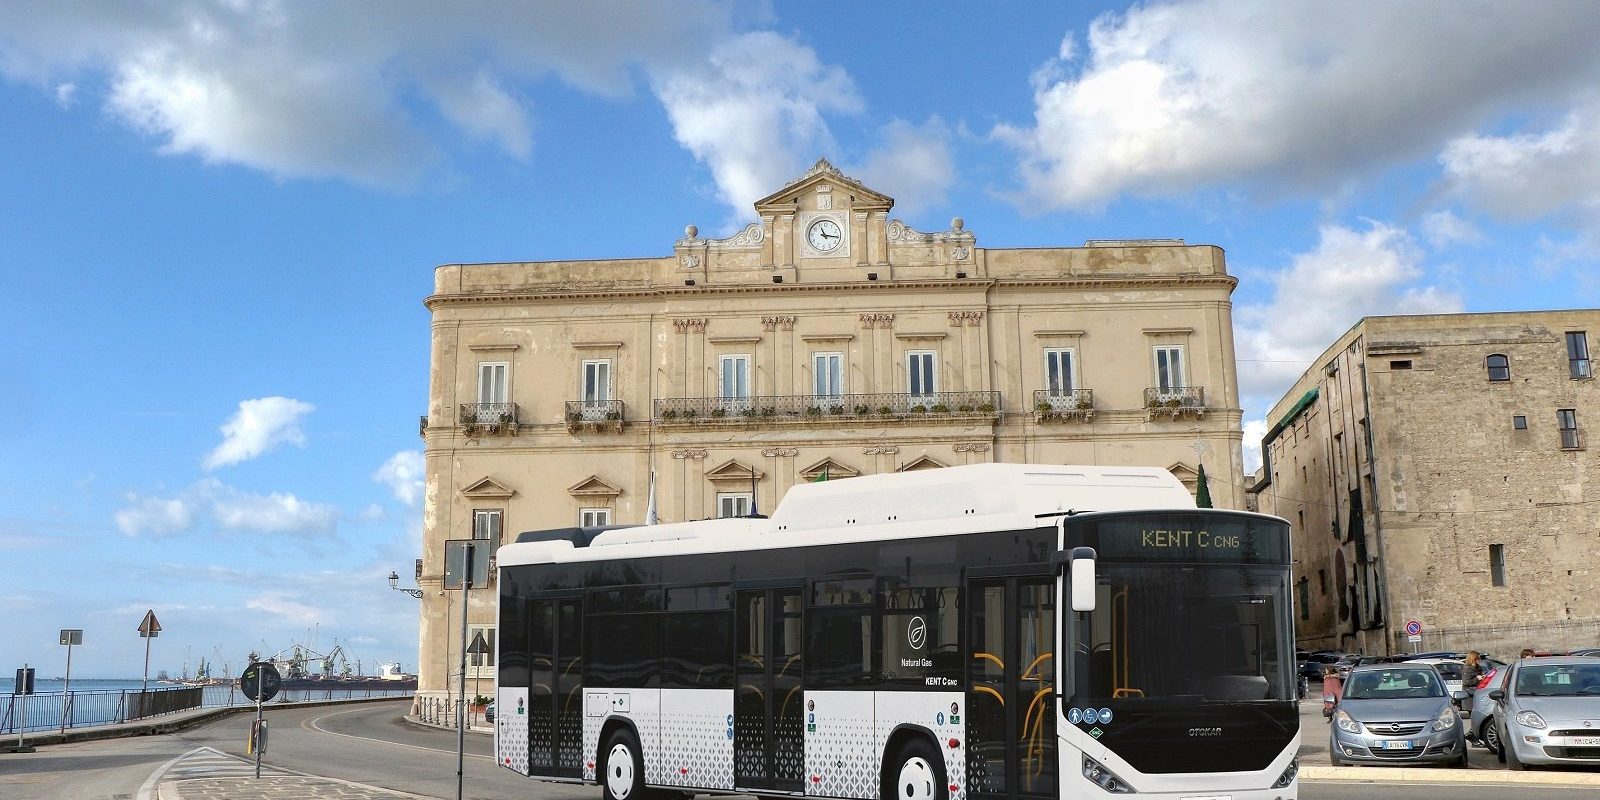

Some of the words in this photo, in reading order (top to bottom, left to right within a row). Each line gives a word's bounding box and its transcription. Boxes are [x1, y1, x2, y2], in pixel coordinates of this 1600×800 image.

[1142, 530, 1193, 547] KENT
[1198, 531, 1209, 547] C
[1214, 535, 1240, 548] CNG
[901, 658, 920, 667] Natural
[921, 658, 932, 667] Gas
[925, 676, 942, 686] KENT
[1189, 727, 1222, 737] OTOKAR
